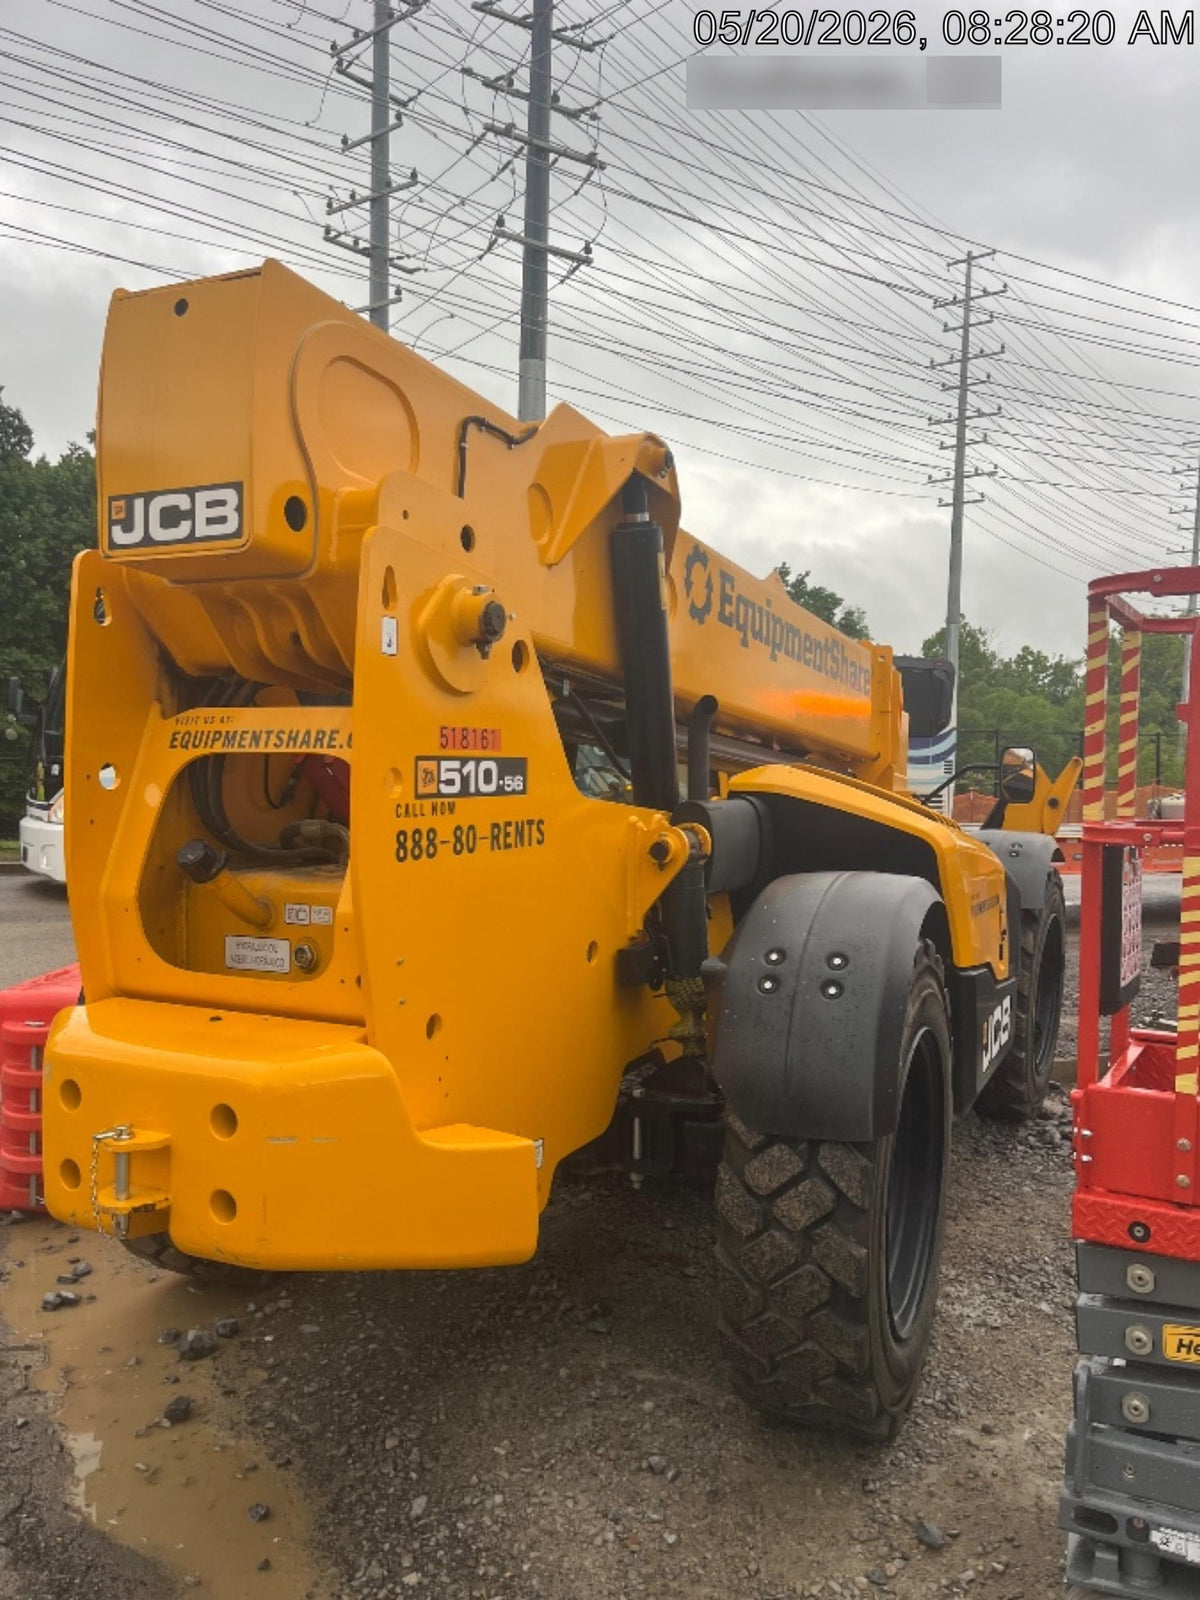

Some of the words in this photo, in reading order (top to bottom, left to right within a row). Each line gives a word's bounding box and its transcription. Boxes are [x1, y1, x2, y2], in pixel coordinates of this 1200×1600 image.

[111, 488, 239, 545] JCB
[717, 569, 870, 697] EquipmentShare
[439, 726, 498, 749] 518161
[395, 803, 426, 818] CALL
[431, 801, 456, 816] NOW
[395, 818, 545, 863] 888-80-RENTS
[983, 995, 1012, 1073] JCB
